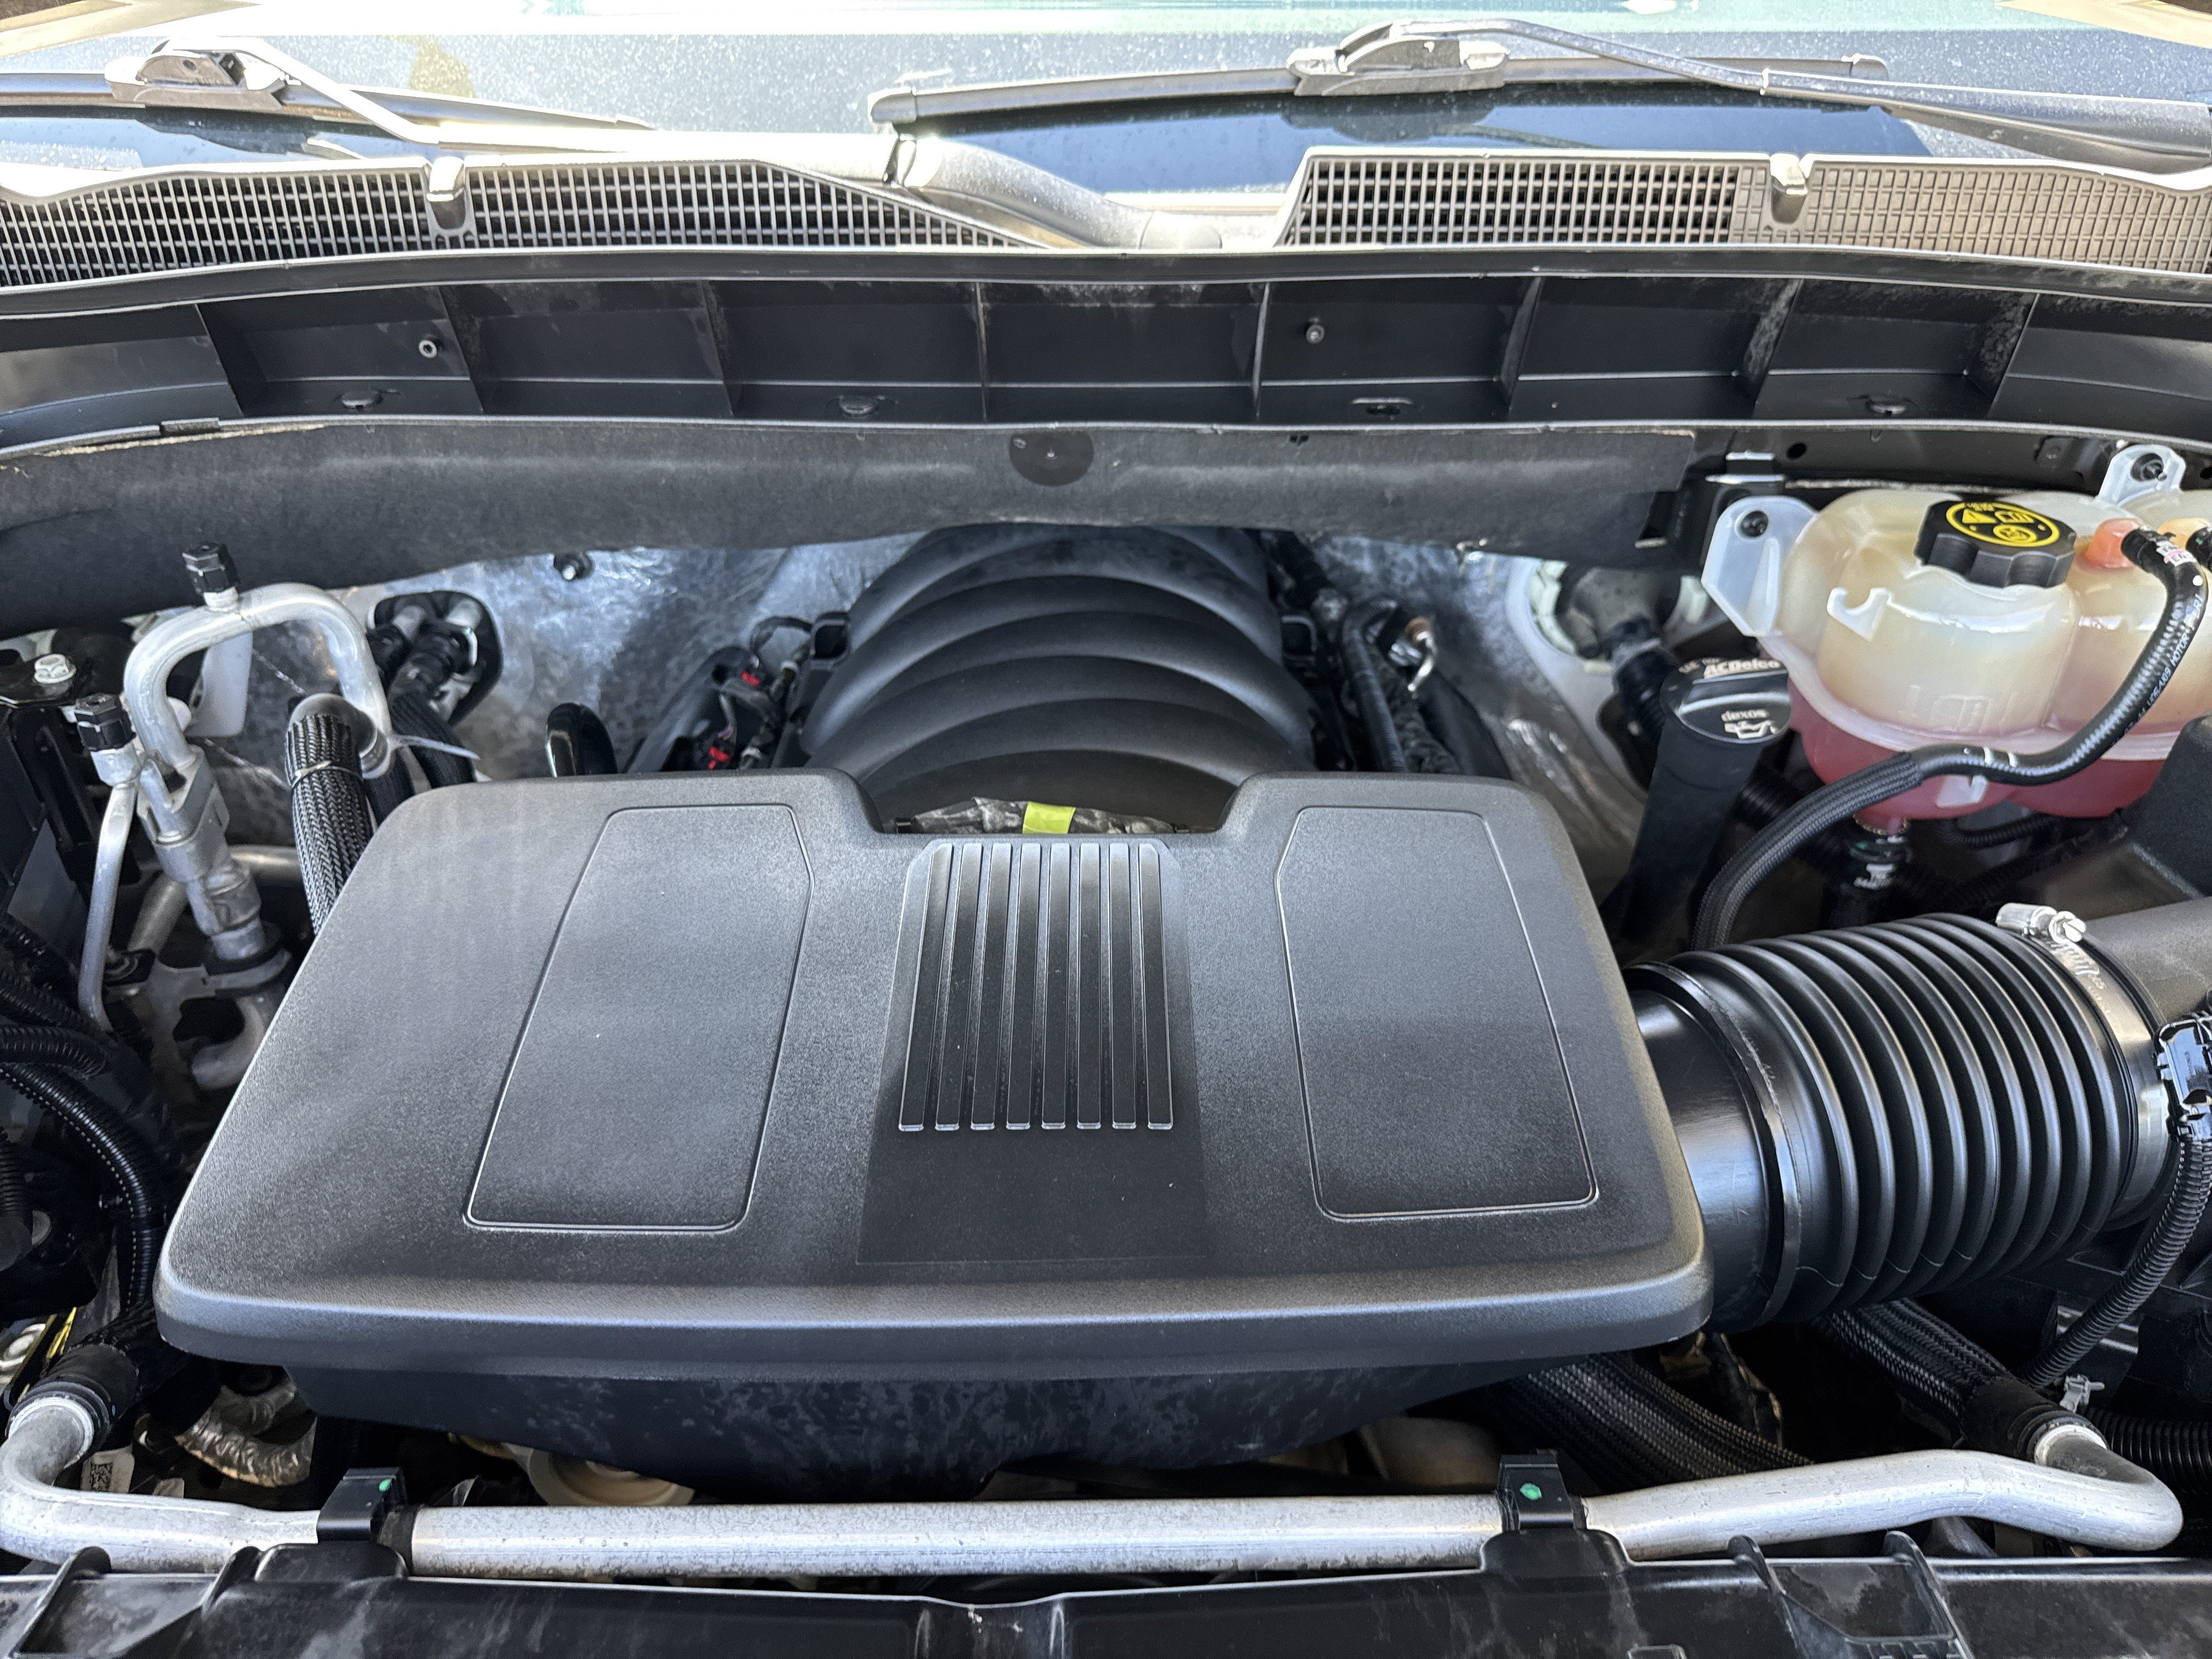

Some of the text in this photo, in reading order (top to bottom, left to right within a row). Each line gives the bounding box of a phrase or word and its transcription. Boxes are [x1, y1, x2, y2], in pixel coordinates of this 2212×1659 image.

[2170, 632, 2190, 667] MOTOR
[1703, 659, 1780, 679] ACDelco
[1721, 709, 1768, 722] dexos
